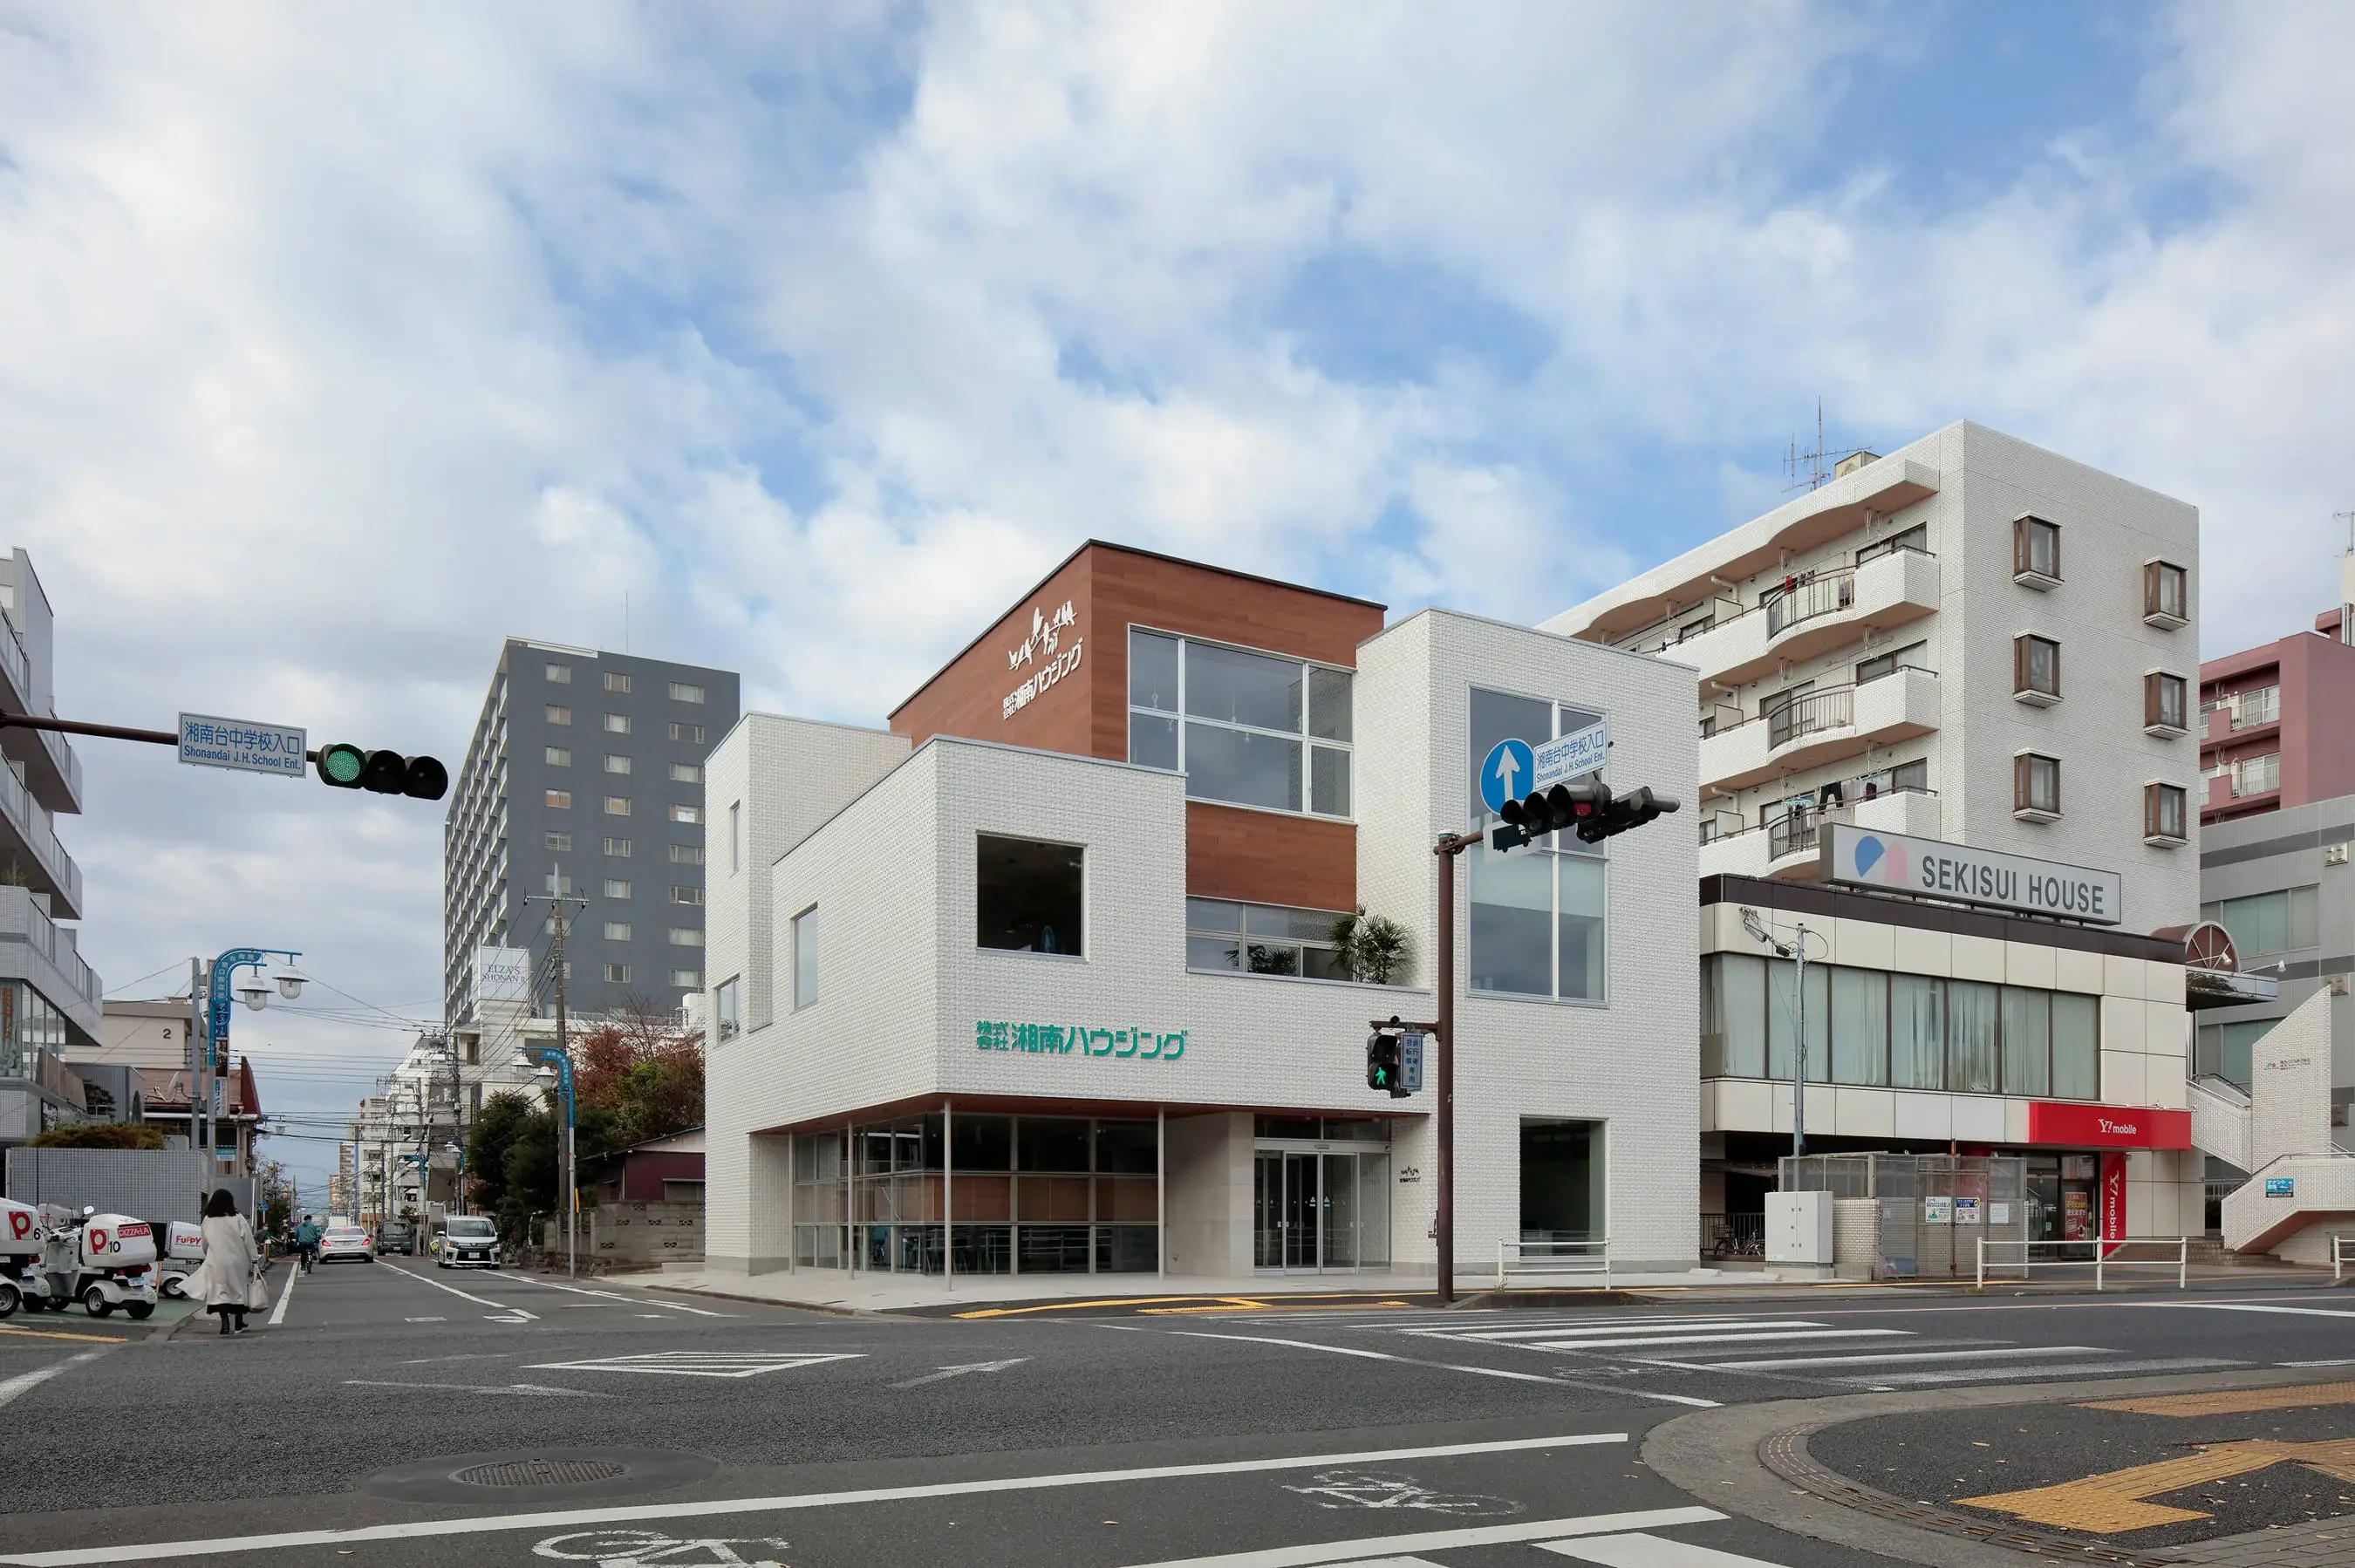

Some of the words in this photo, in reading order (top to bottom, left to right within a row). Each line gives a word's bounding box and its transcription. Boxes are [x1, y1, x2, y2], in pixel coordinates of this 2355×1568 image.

[184, 721, 300, 755] 湘南台中学校入口
[184, 745, 230, 761] Shonandai
[284, 757, 301, 769] Ent.
[1537, 730, 1604, 771] 湘南台中学校入口
[1536, 767, 1563, 783] Shonandai
[1594, 752, 1605, 762] Ent.
[1922, 856, 2017, 901] SEKISUI
[2029, 874, 2104, 915] HOUSE
[482, 974, 519, 983] SHONAN
[163, 1028, 171, 1039] 2
[33, 1228, 41, 1241] 6
[109, 1240, 120, 1253] 10
